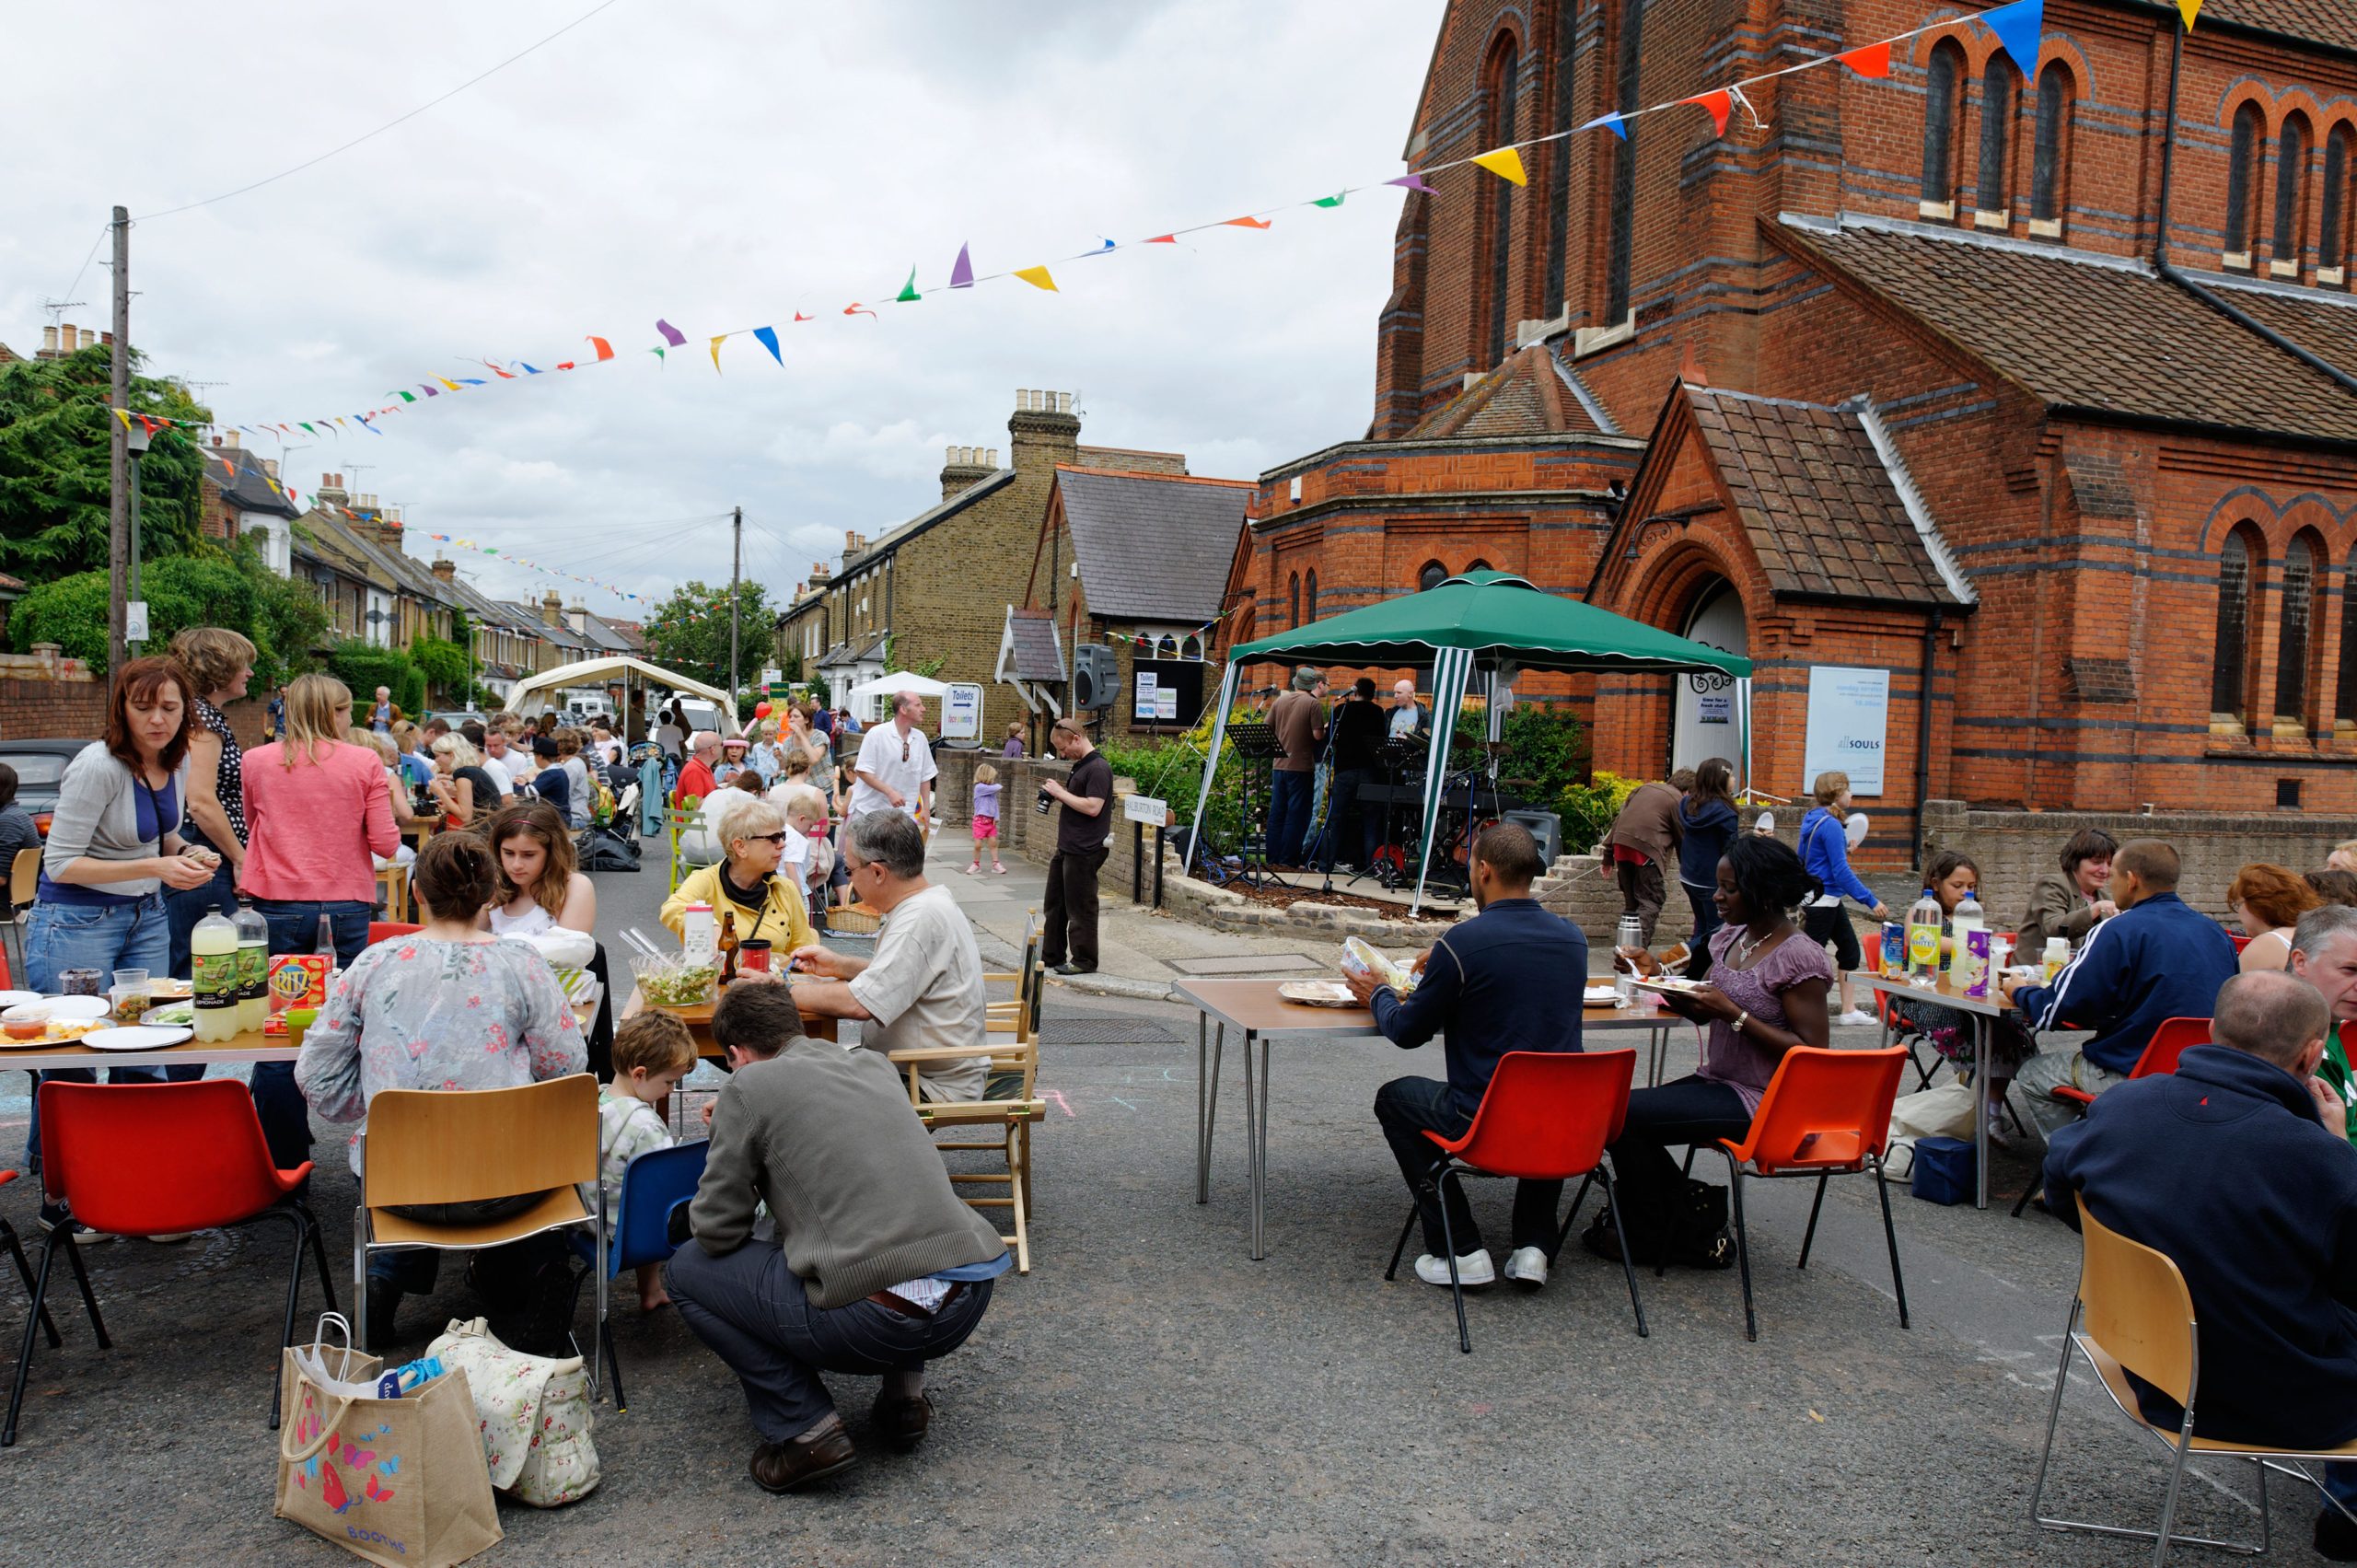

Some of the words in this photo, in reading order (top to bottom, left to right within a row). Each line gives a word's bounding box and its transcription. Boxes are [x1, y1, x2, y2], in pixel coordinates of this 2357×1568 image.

[952, 690, 974, 701] Toilets
[277, 970, 309, 992] RITZ
[346, 1525, 406, 1554] BOOTHS
